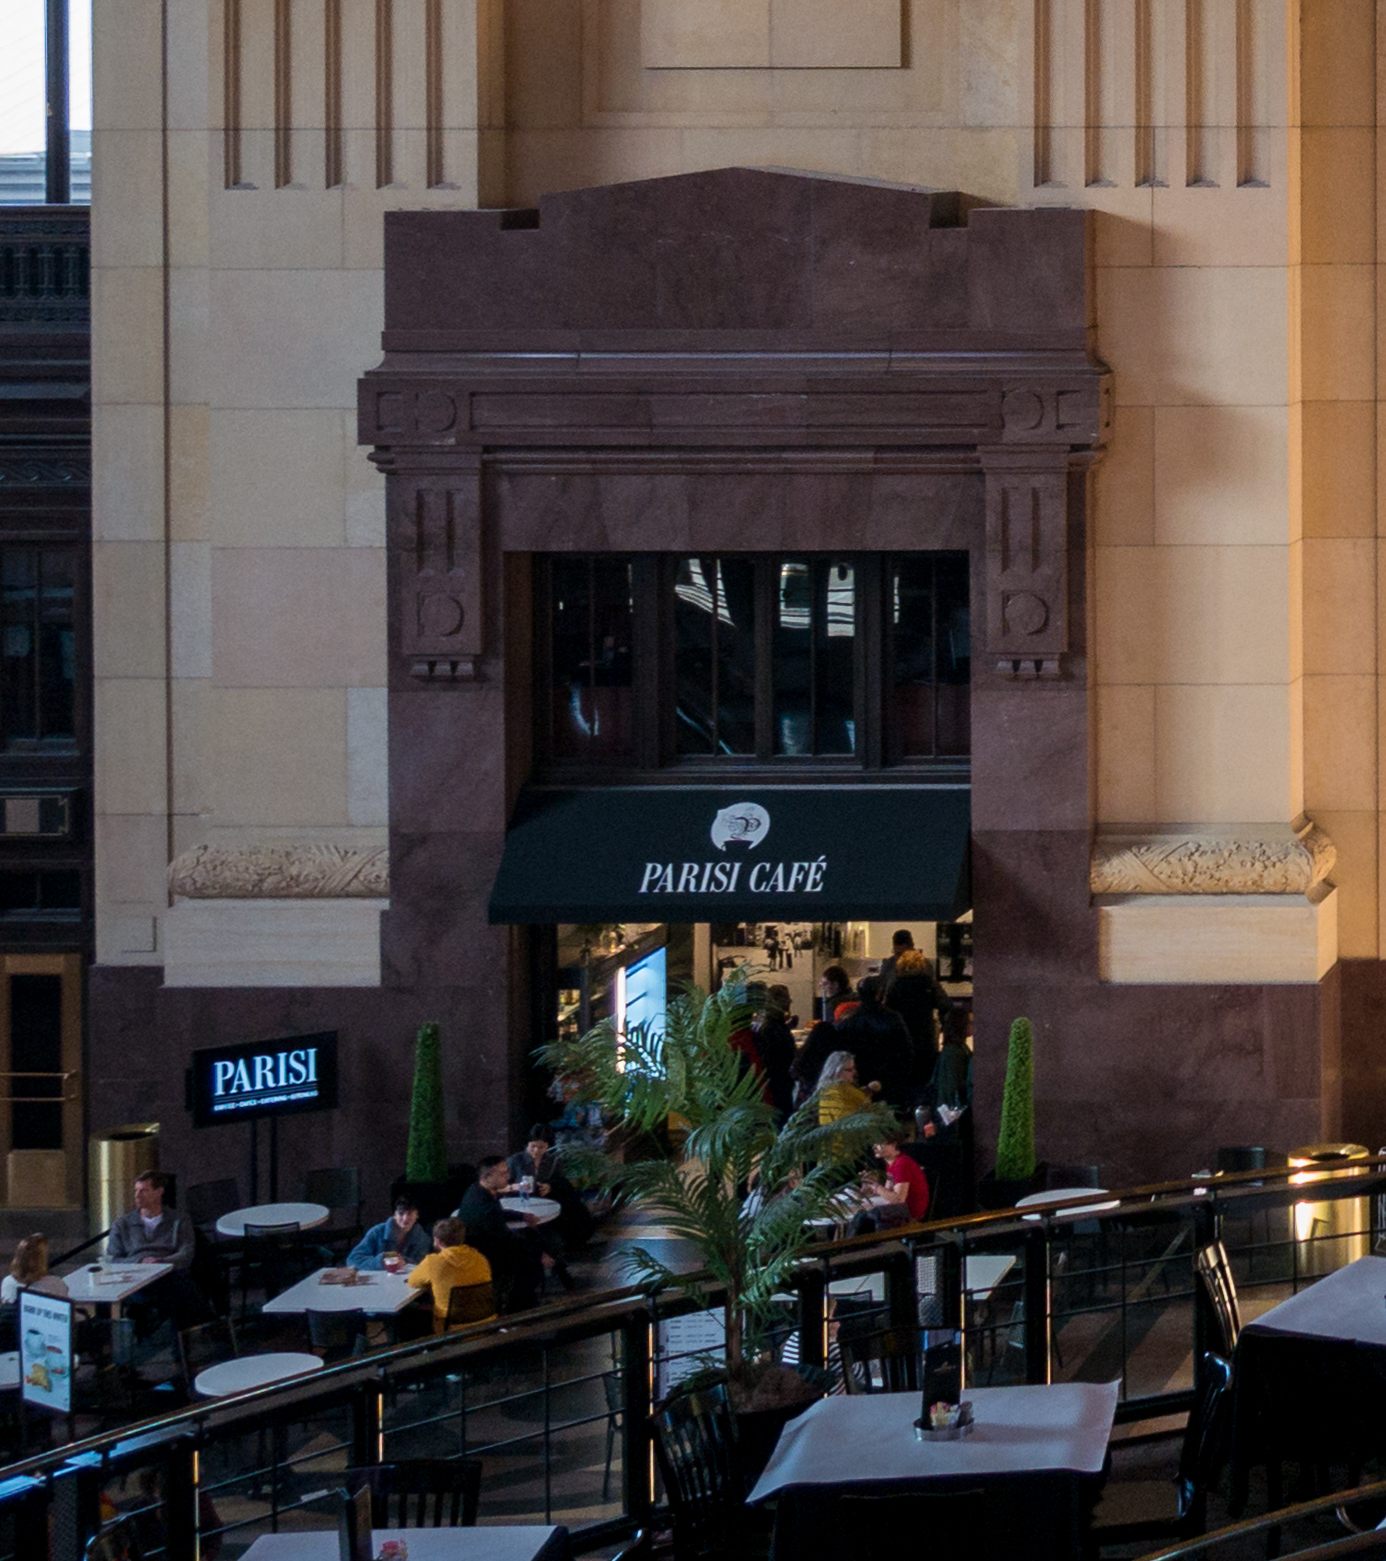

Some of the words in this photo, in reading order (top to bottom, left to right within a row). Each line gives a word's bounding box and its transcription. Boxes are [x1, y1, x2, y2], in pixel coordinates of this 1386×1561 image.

[638, 862, 742, 893] PARISI
[749, 855, 827, 892] CAFÉ
[213, 1048, 319, 1096] PARISI
